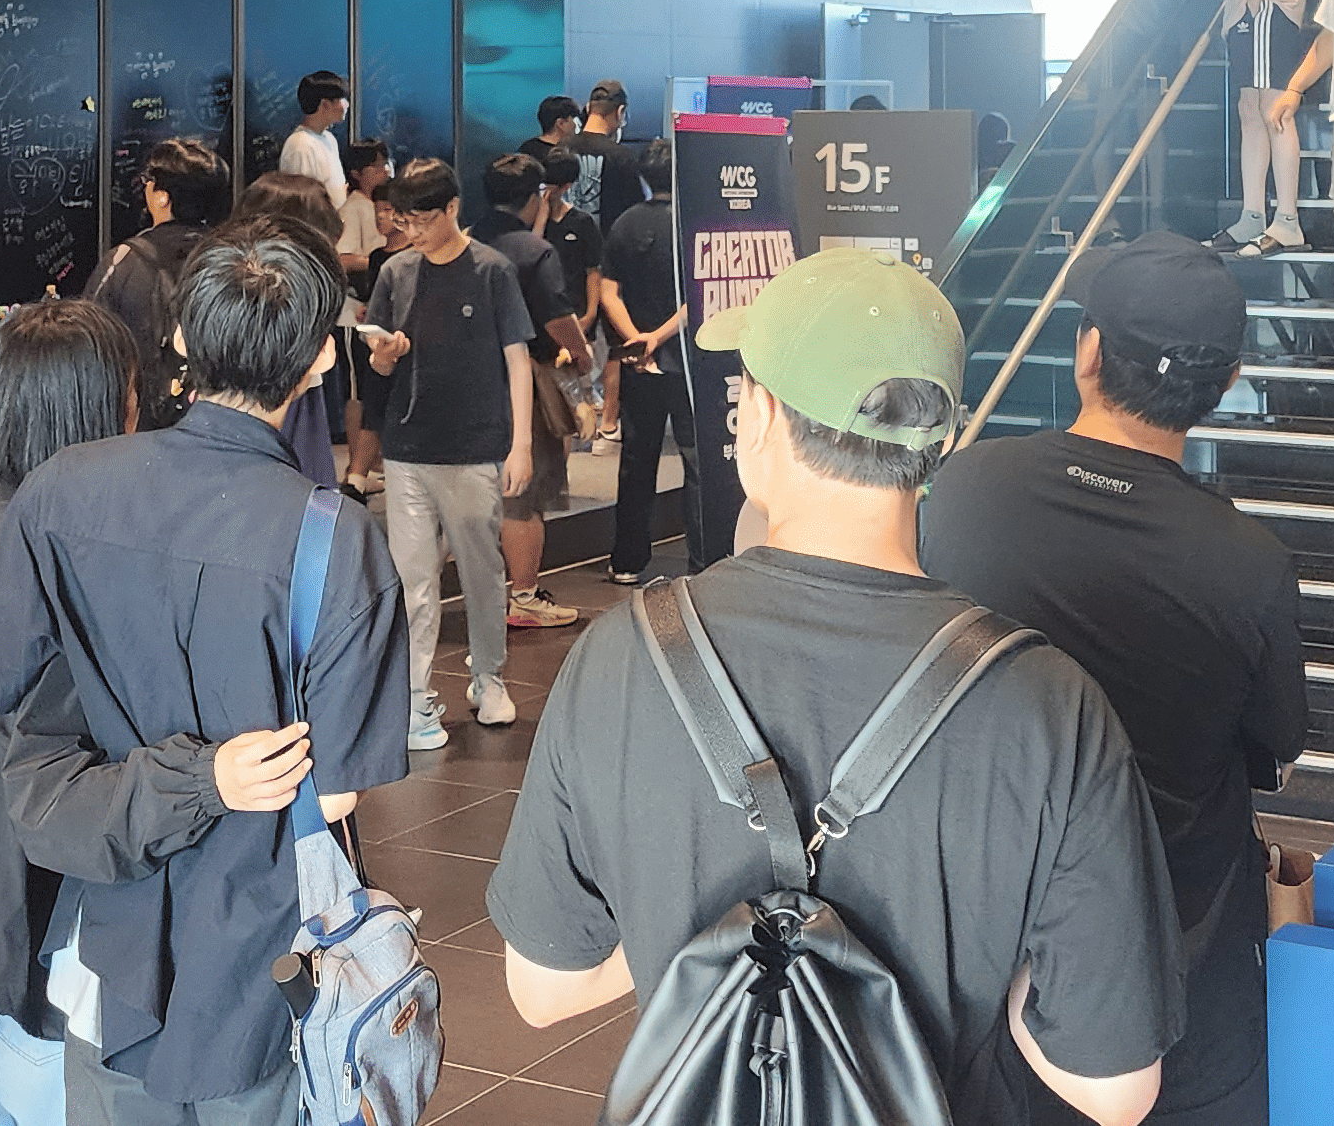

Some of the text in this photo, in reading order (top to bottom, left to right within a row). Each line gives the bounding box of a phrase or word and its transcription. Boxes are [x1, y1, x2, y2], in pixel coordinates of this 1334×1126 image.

[720, 165, 757, 188] WCG
[815, 142, 891, 194] 15F
[693, 230, 796, 280] CREATOR
